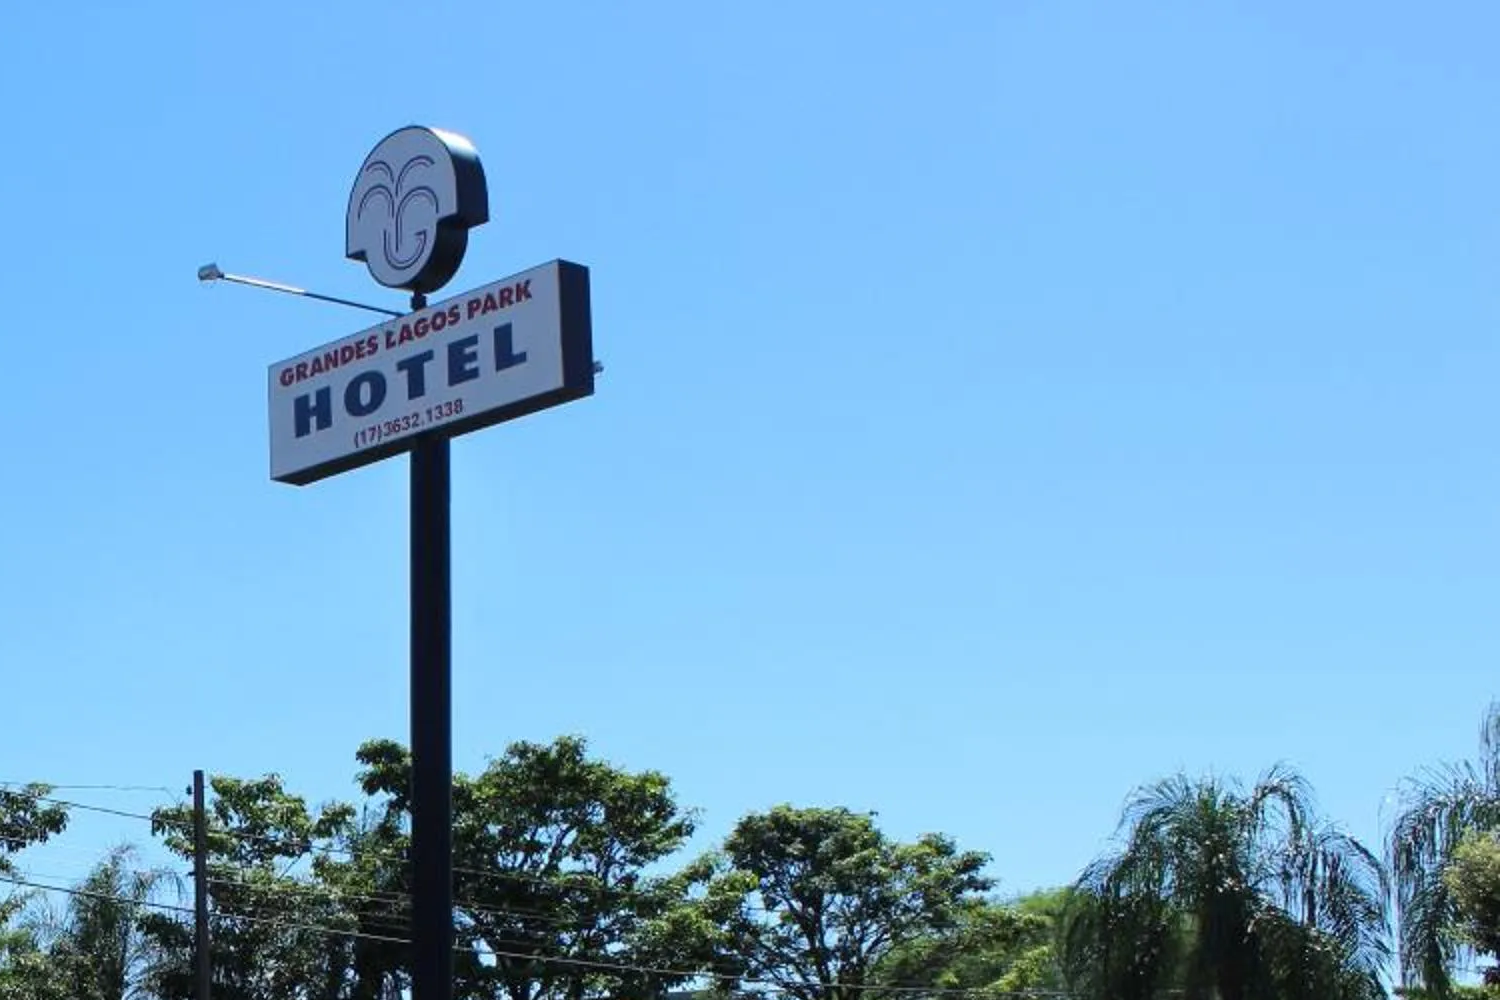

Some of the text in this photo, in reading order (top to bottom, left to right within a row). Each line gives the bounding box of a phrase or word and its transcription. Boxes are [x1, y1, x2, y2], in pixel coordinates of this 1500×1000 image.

[280, 279, 533, 387] GRANDES LAGOS PARK
[294, 322, 527, 438] HOTEL
